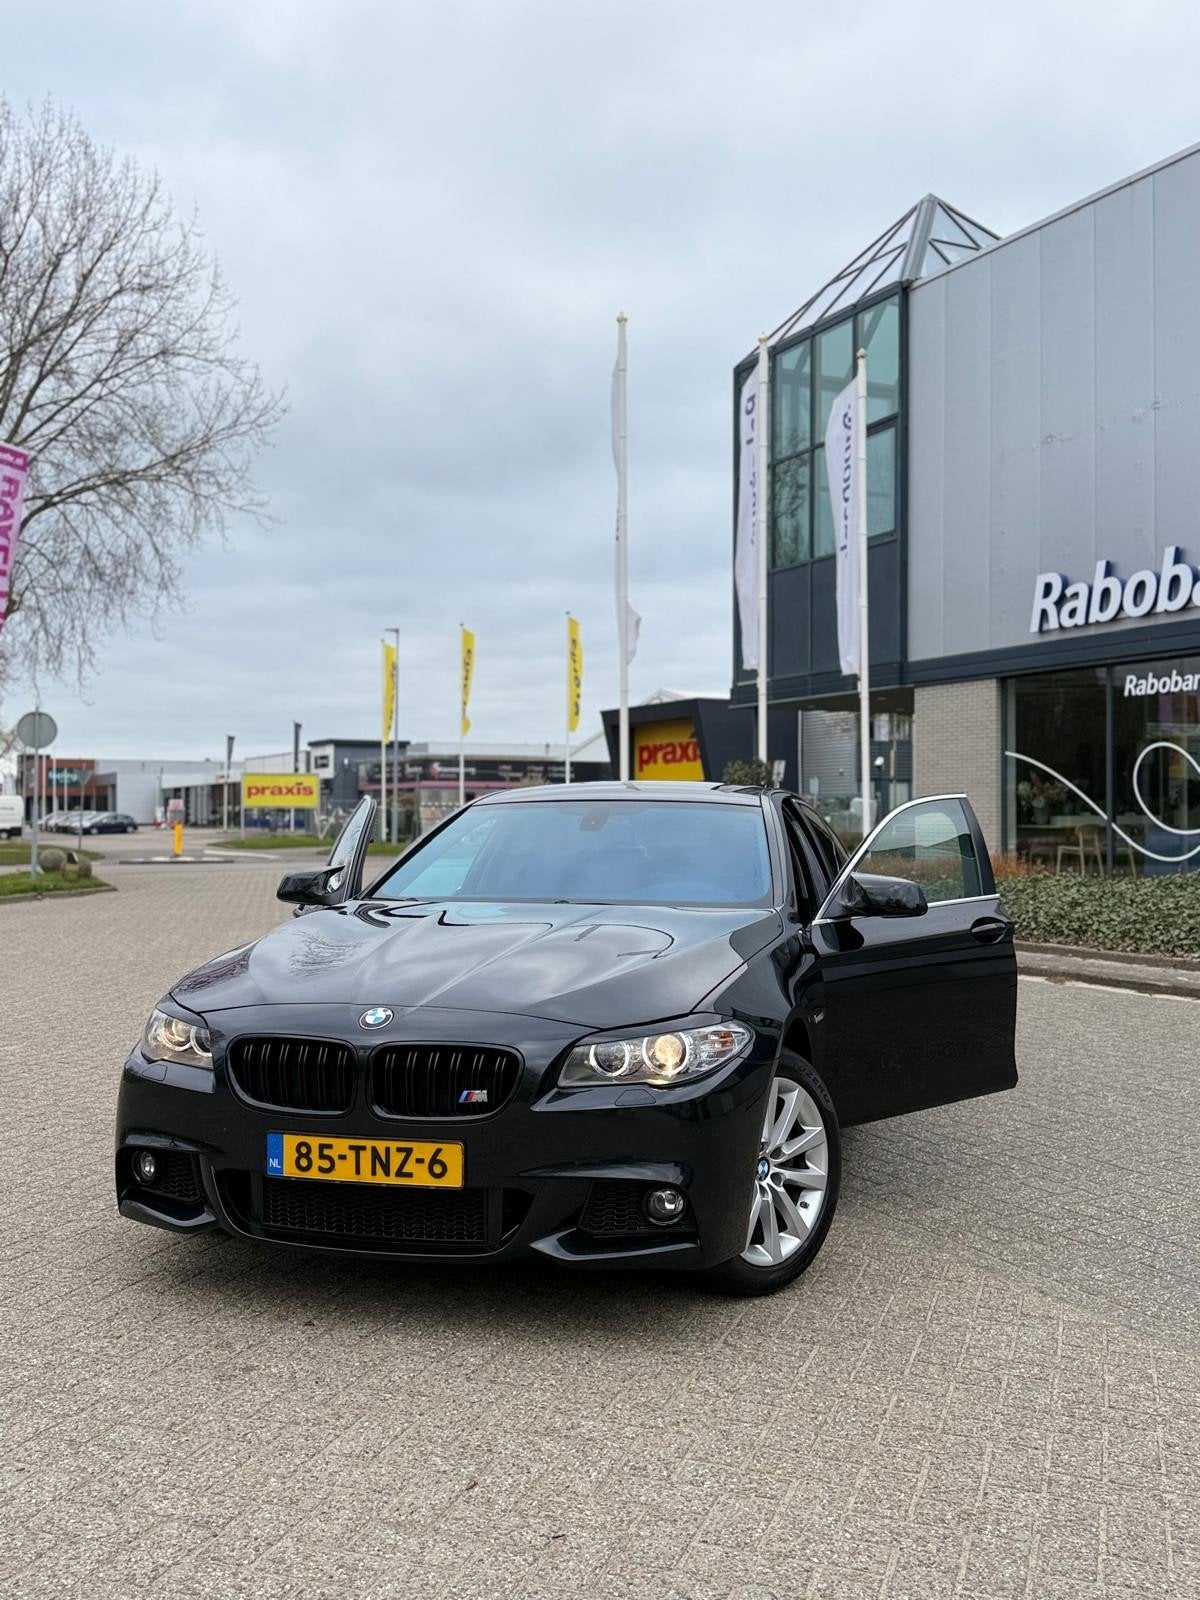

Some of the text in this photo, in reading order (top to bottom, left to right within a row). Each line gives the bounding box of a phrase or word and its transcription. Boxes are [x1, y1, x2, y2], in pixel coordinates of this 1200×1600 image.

[638, 734, 702, 773] praxi
[247, 782, 313, 799] praxis
[269, 1157, 281, 1168] NL
[295, 1141, 448, 1180] 85-TNZ-6
